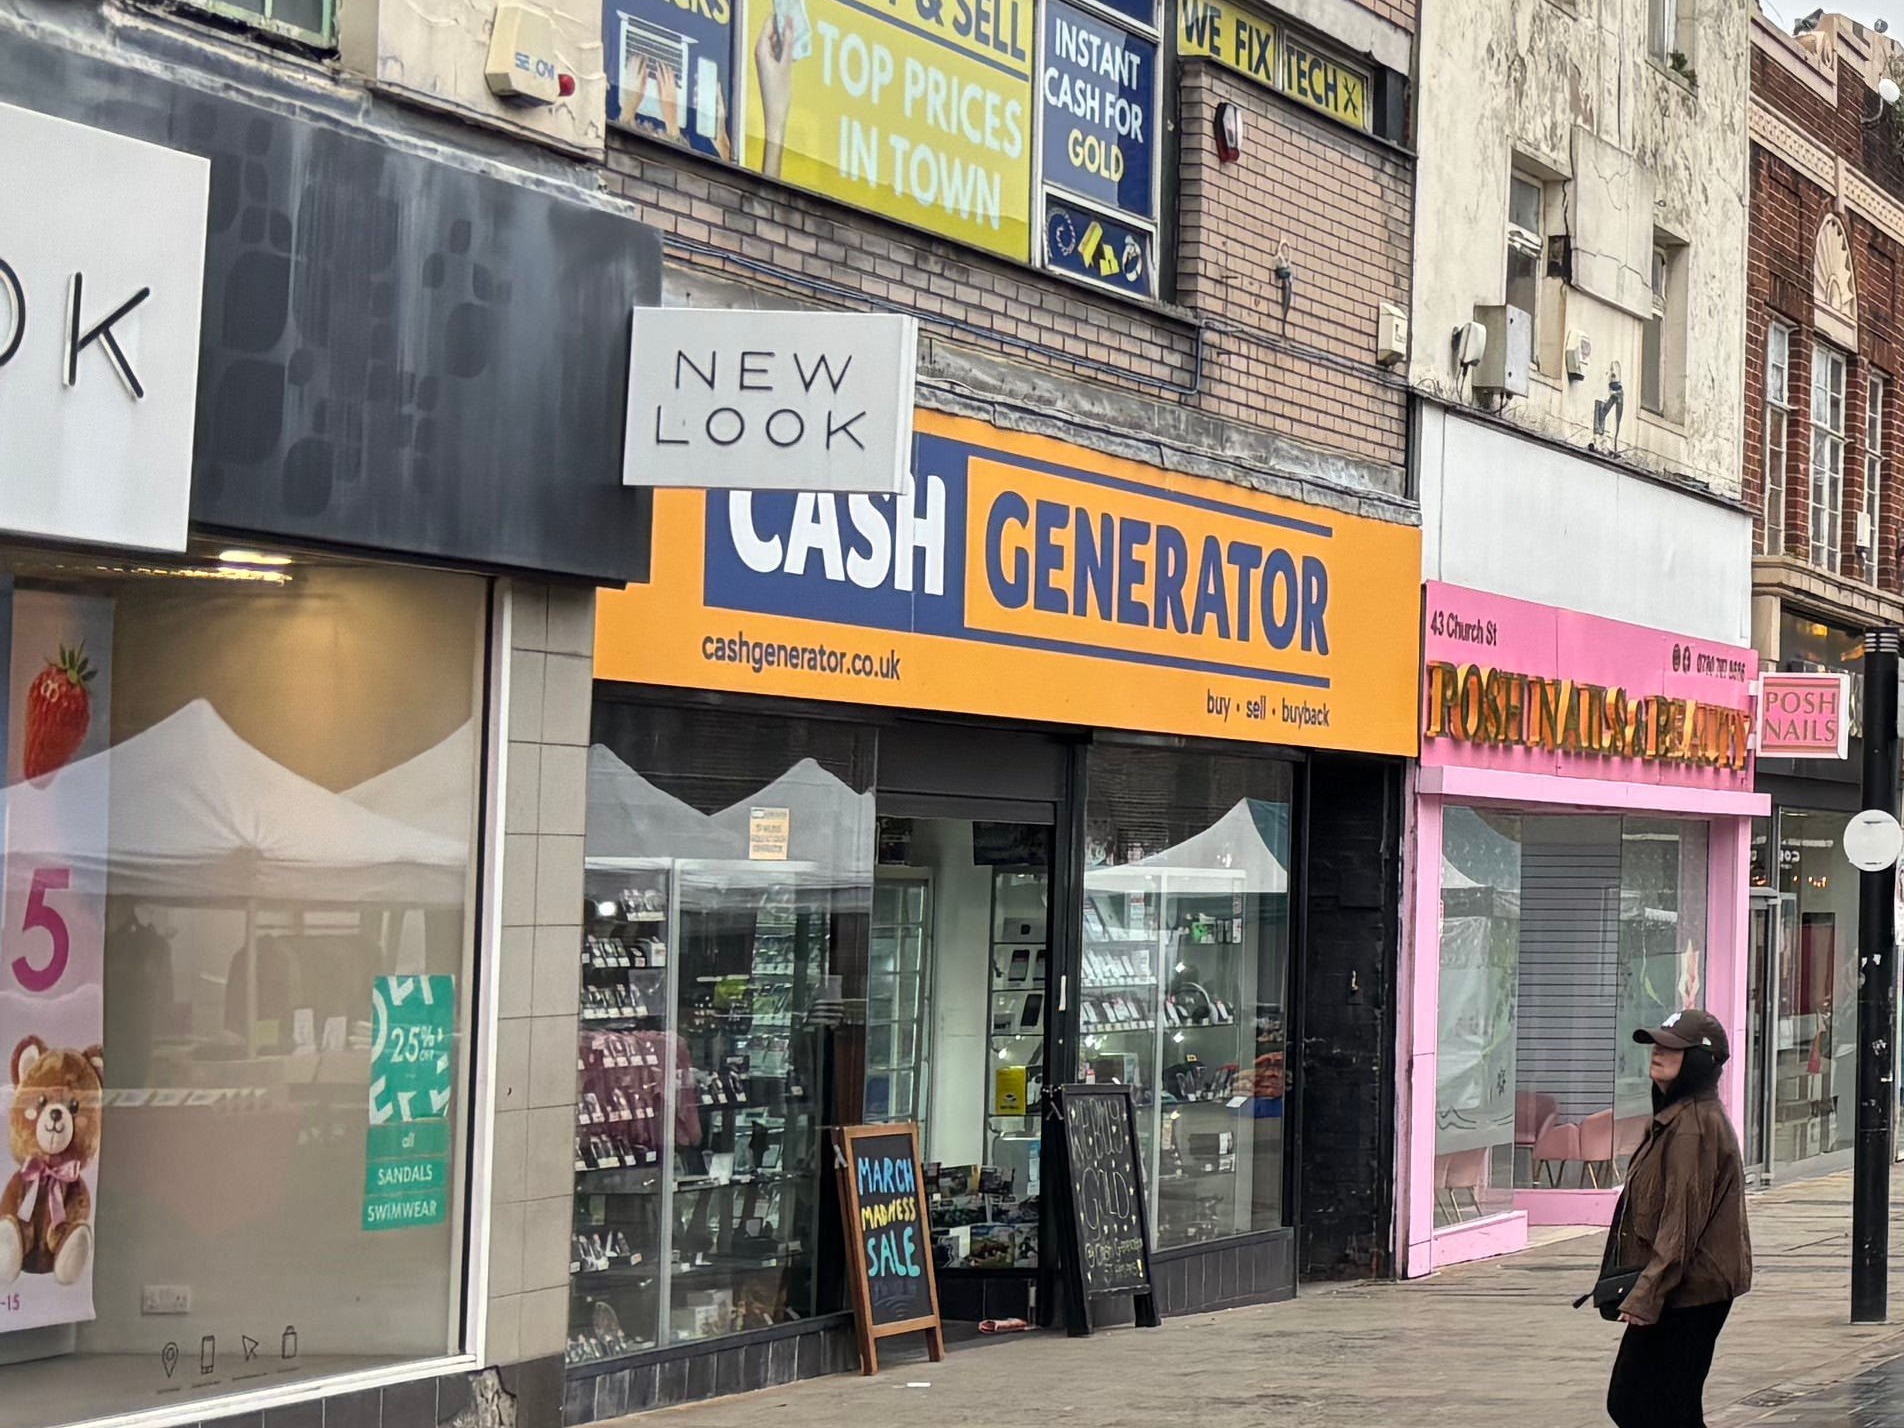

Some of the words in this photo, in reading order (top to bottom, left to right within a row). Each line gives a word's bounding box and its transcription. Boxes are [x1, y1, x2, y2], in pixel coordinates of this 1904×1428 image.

[1055, 17, 1140, 90] INSTANT
[1234, 16, 1274, 72] FIX
[1285, 46, 1338, 112] TECH
[819, 21, 892, 106] TOP
[903, 57, 1023, 159] PRICES
[1045, 69, 1100, 124] CASH
[1105, 87, 1144, 142] FOR
[840, 116, 878, 190] IN
[890, 135, 1000, 232] TOWN
[1068, 130, 1125, 184] GOLD
[0, 258, 151, 400] K
[675, 352, 853, 395] NEW
[655, 406, 867, 451] LOOK
[728, 475, 946, 596] CASH
[987, 489, 1330, 656] GENERATOR
[1431, 610, 1444, 636] 43
[1447, 613, 1483, 644] Church
[1486, 621, 1497, 646] St
[703, 632, 900, 681] cashgenerator.co.uk
[1207, 690, 1231, 724] buy
[1246, 694, 1266, 720] sell
[1281, 697, 1330, 729] buyback
[1426, 661, 1528, 743] POSH
[1528, 676, 1627, 753] NAILS
[1766, 691, 1836, 714] POSH
[1763, 719, 1837, 742] NAILS
[11, 868, 71, 993] 5
[378, 1164, 432, 1185] SANDALS
[858, 1157, 915, 1196] MARCH
[368, 1201, 437, 1222] SWIMWEAR
[862, 1196, 917, 1232] MADNESS
[867, 1226, 921, 1277] SALE
